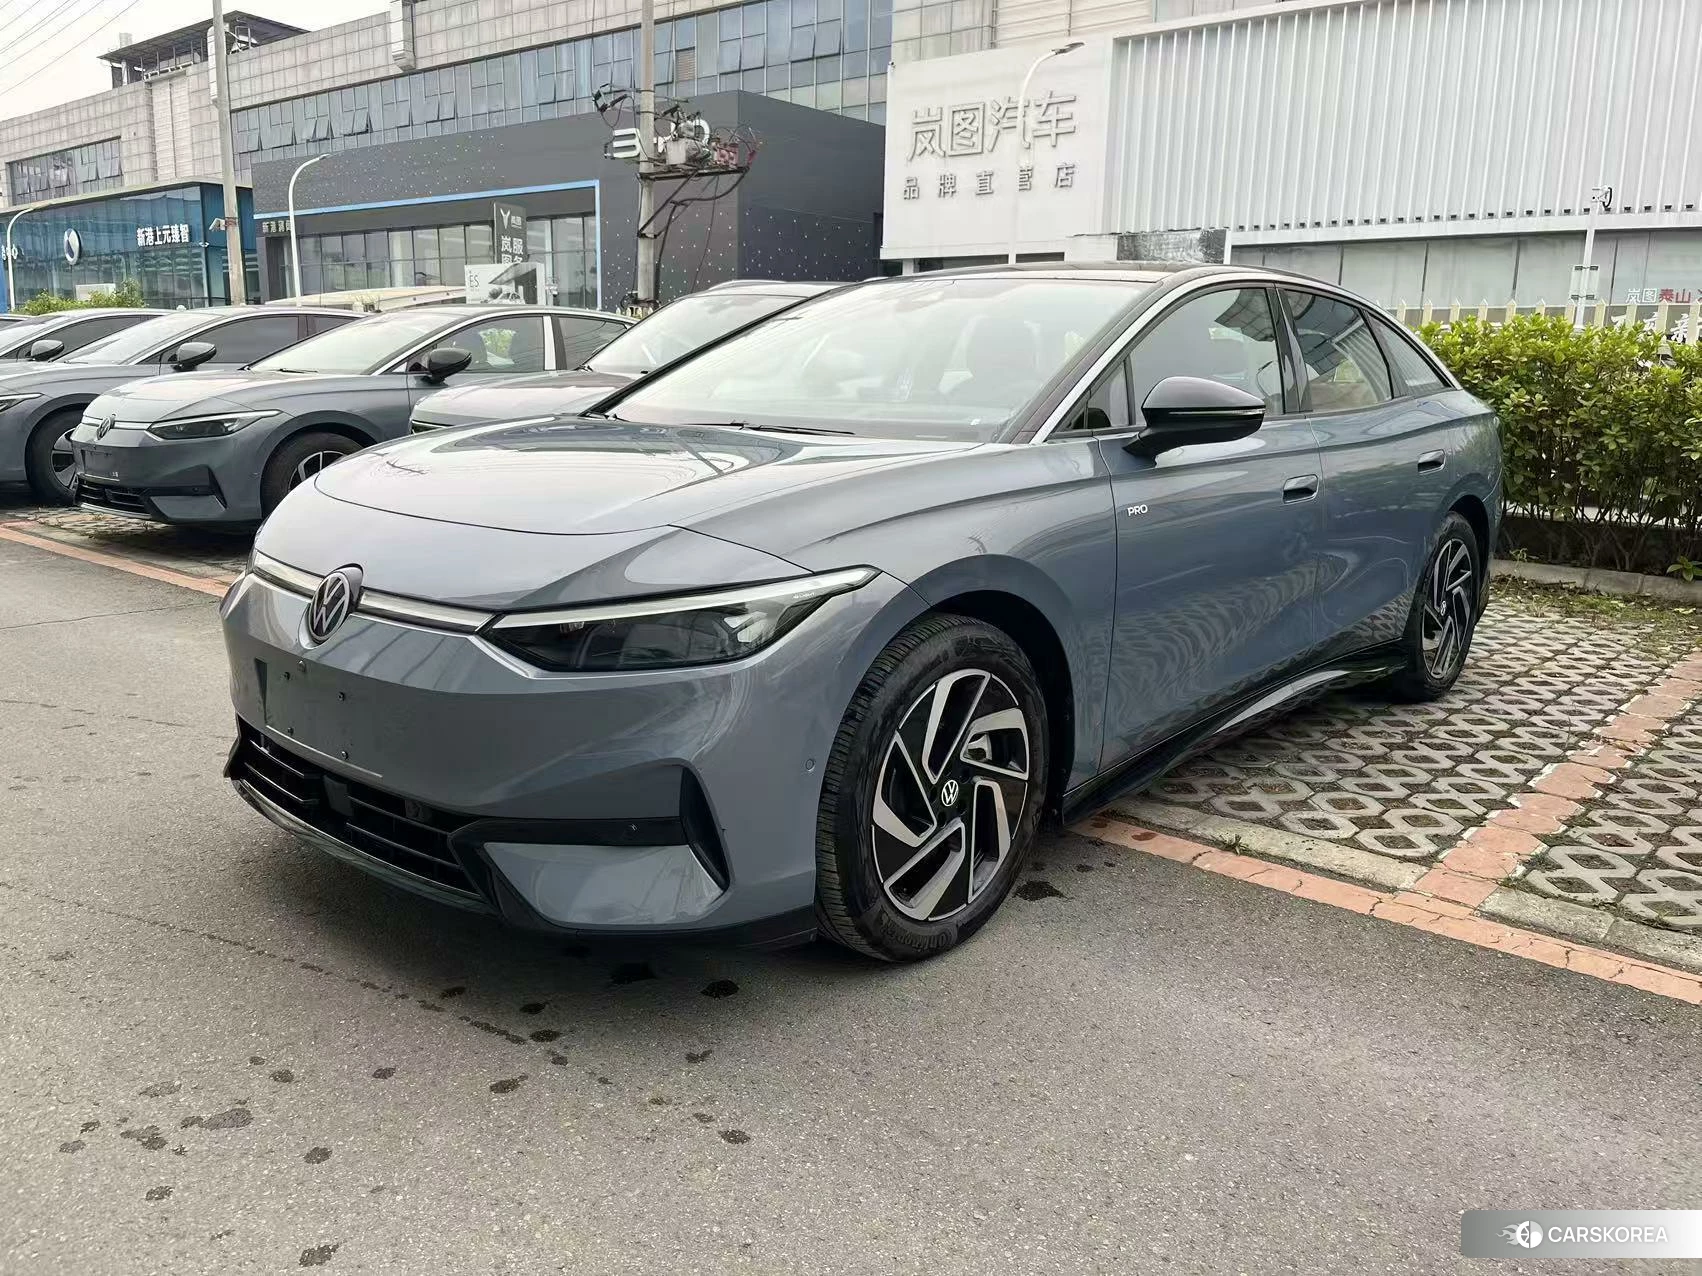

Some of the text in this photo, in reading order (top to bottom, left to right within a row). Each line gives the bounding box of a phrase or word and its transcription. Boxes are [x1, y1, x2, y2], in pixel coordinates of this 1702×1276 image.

[906, 90, 1078, 161] 岚图汽车
[902, 161, 1077, 201] 品牌直营店
[1625, 287, 1692, 304] 岚图泰山
[1127, 504, 1148, 516] PRO
